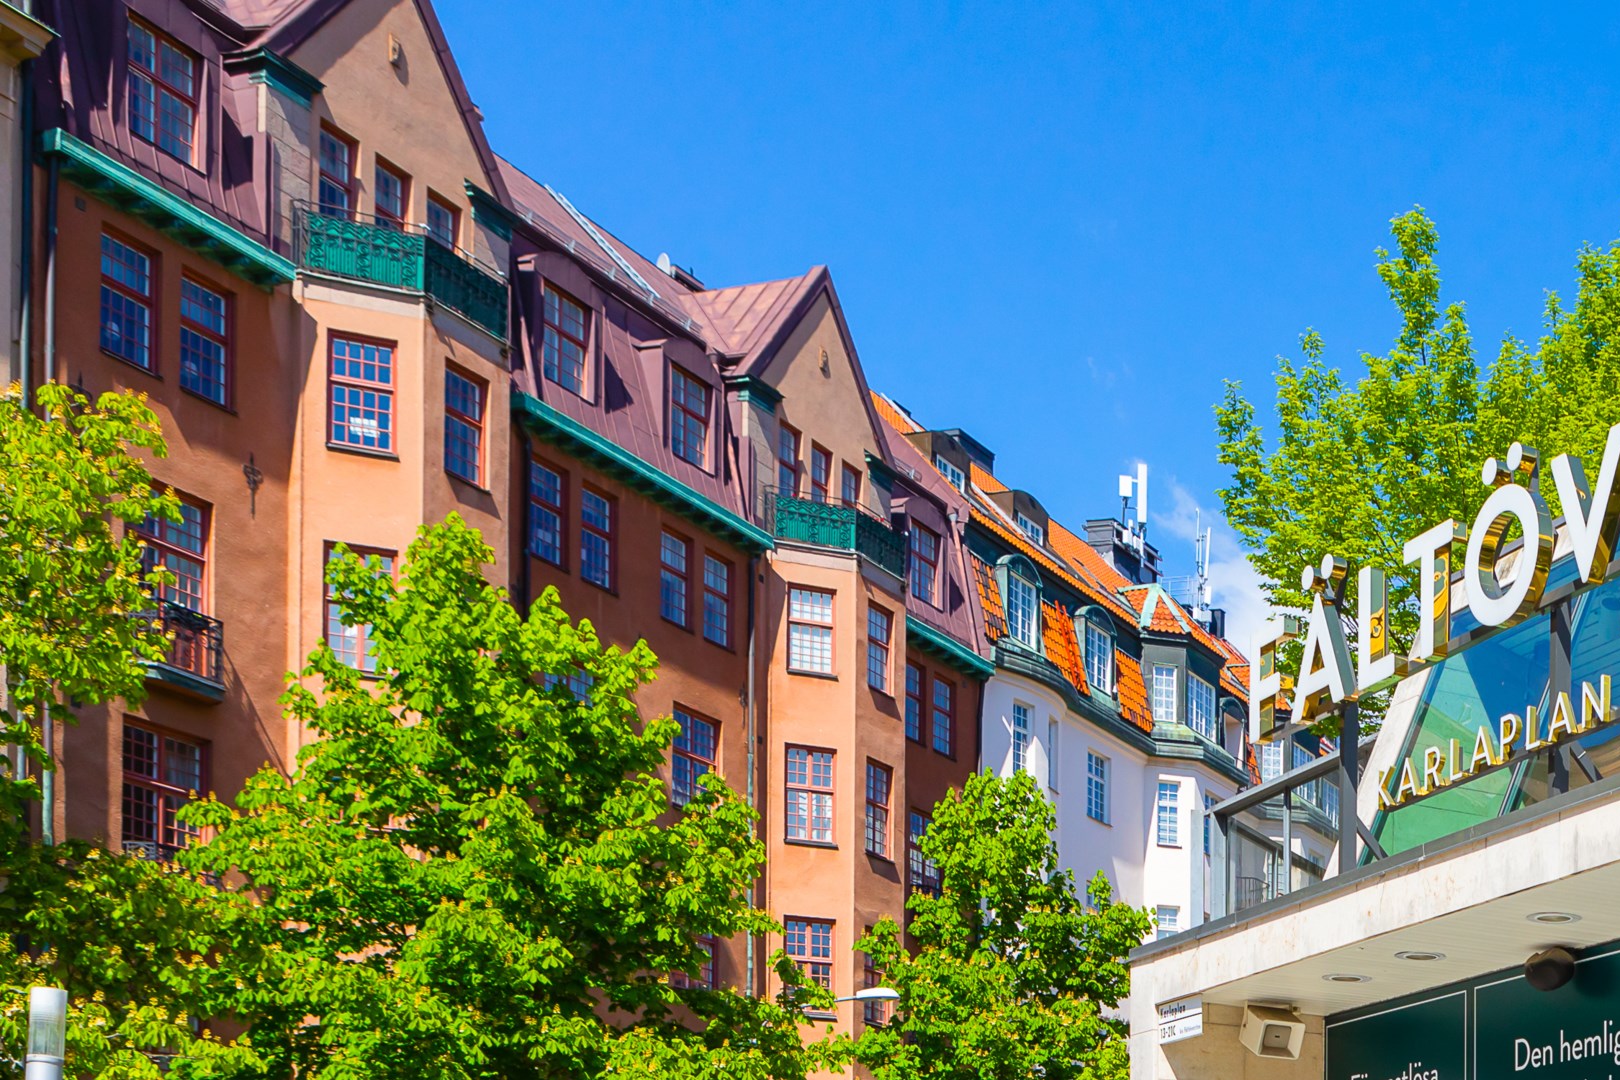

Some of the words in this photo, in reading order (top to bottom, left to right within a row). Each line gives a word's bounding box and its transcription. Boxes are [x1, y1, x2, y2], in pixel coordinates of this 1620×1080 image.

[1376, 672, 1613, 811] KARLAPLAN
[1160, 1024, 1176, 1040] 13-21C
[1513, 1036, 1554, 1072] Den
